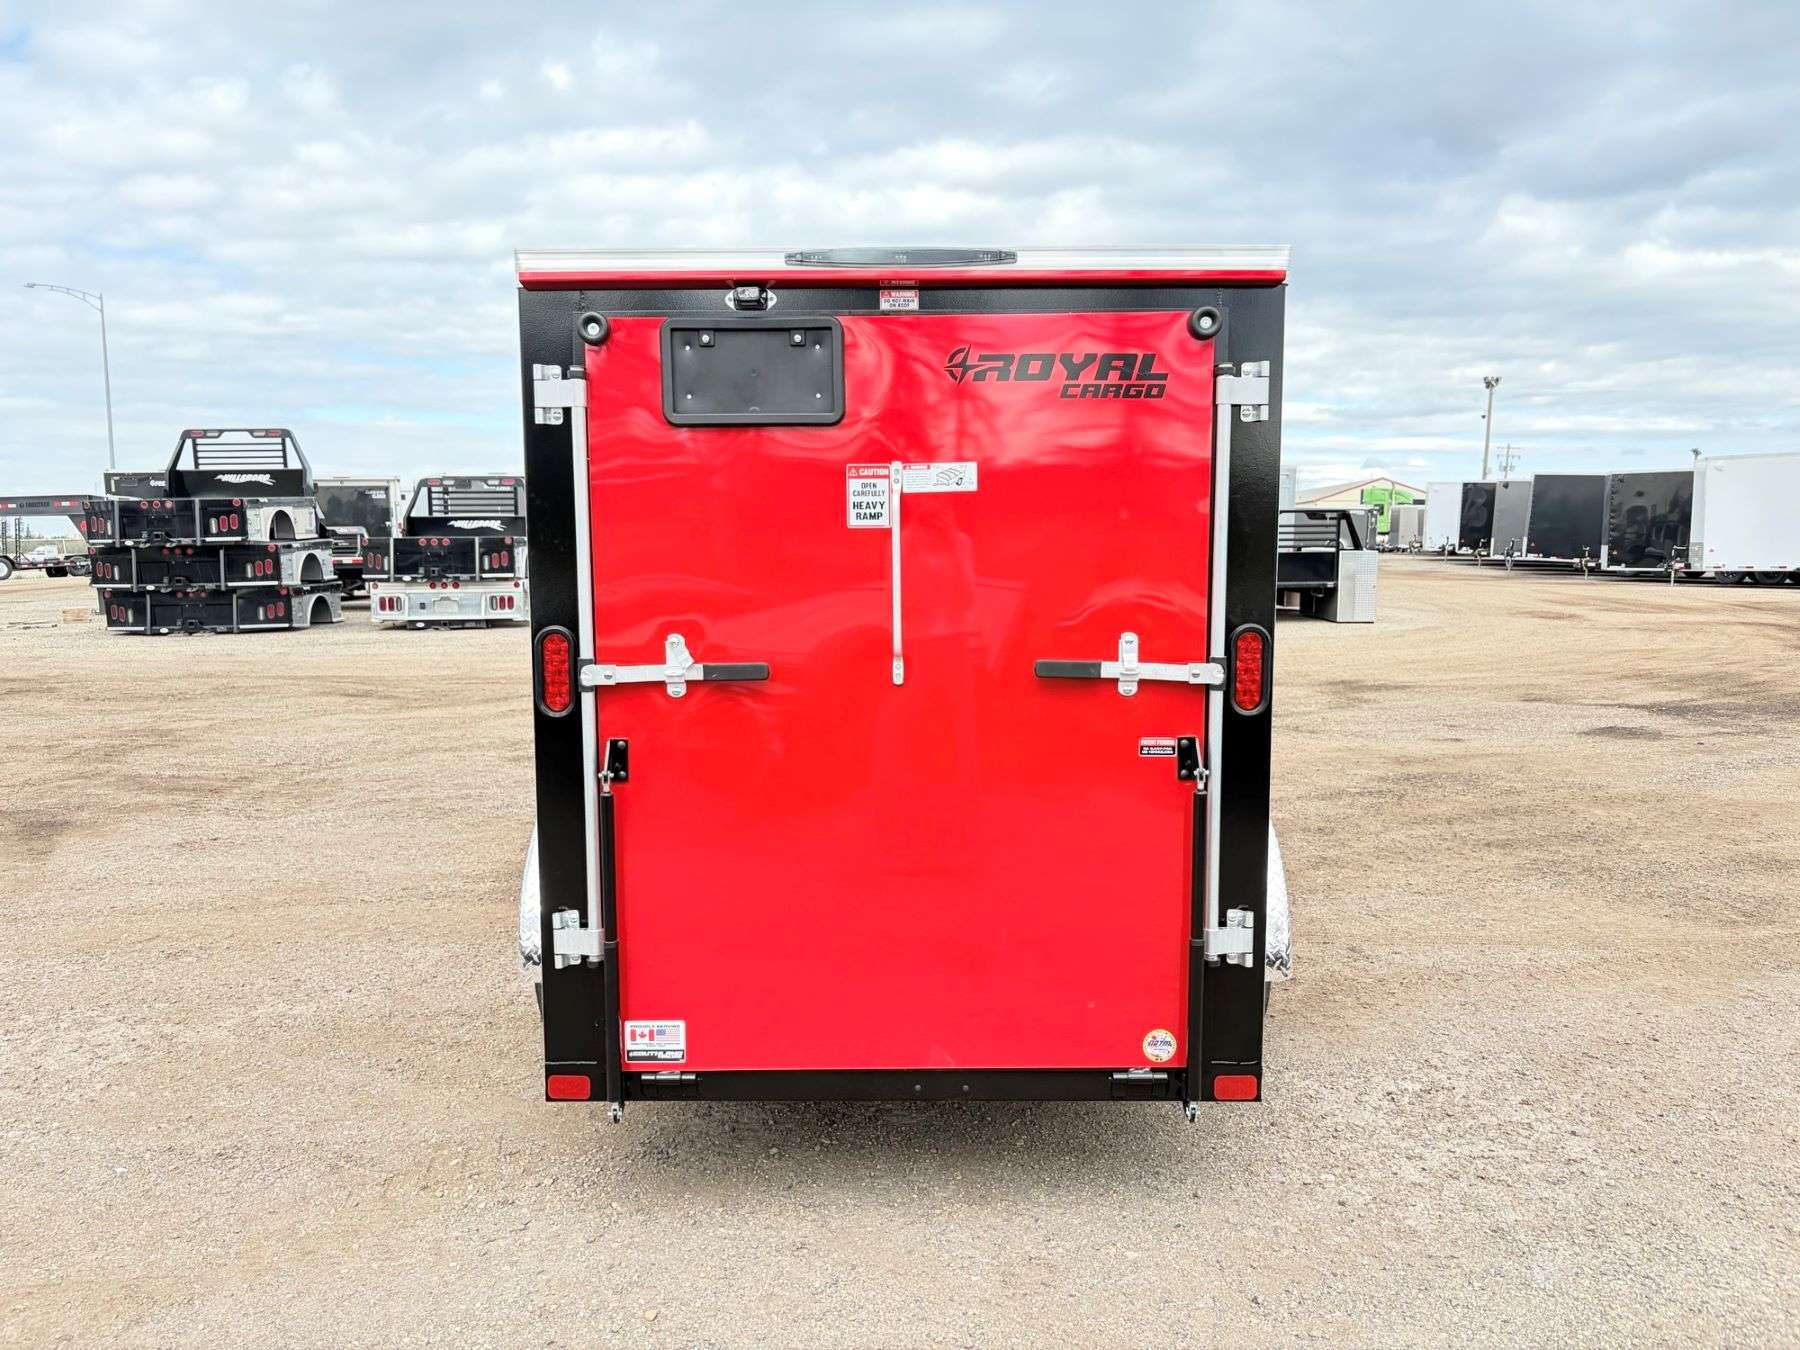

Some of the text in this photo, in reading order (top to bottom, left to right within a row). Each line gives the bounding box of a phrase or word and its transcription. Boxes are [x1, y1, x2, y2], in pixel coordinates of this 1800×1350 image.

[891, 290, 915, 298] WARNING
[972, 353, 1169, 382] ROYAL
[1060, 383, 1167, 399] CARGO
[859, 468, 889, 476] CAUTION
[852, 501, 886, 510] HEAVY
[855, 512, 883, 520] RAMP
